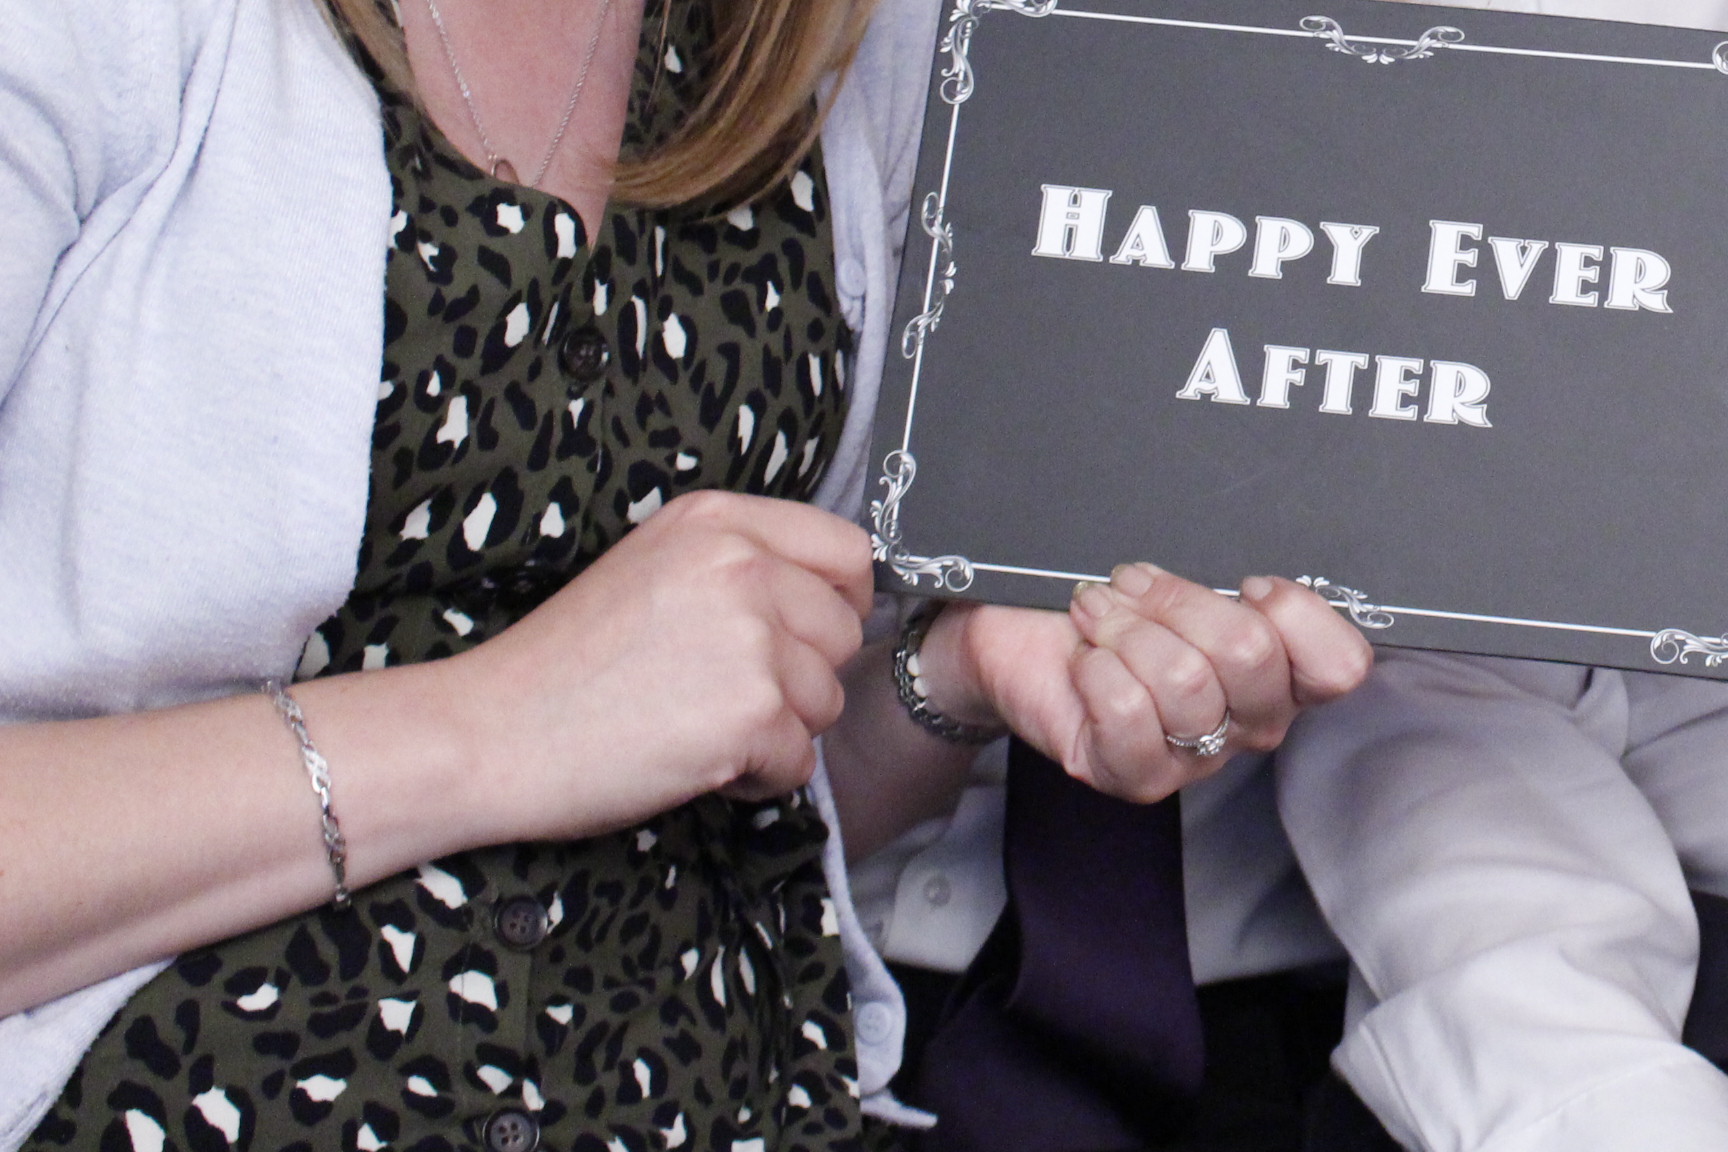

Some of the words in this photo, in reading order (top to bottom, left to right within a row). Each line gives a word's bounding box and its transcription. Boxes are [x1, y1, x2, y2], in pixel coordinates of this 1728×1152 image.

[1031, 183, 1380, 287] HAPPY
[1420, 219, 1674, 314] EVER
[1175, 328, 1494, 428] AFTER
